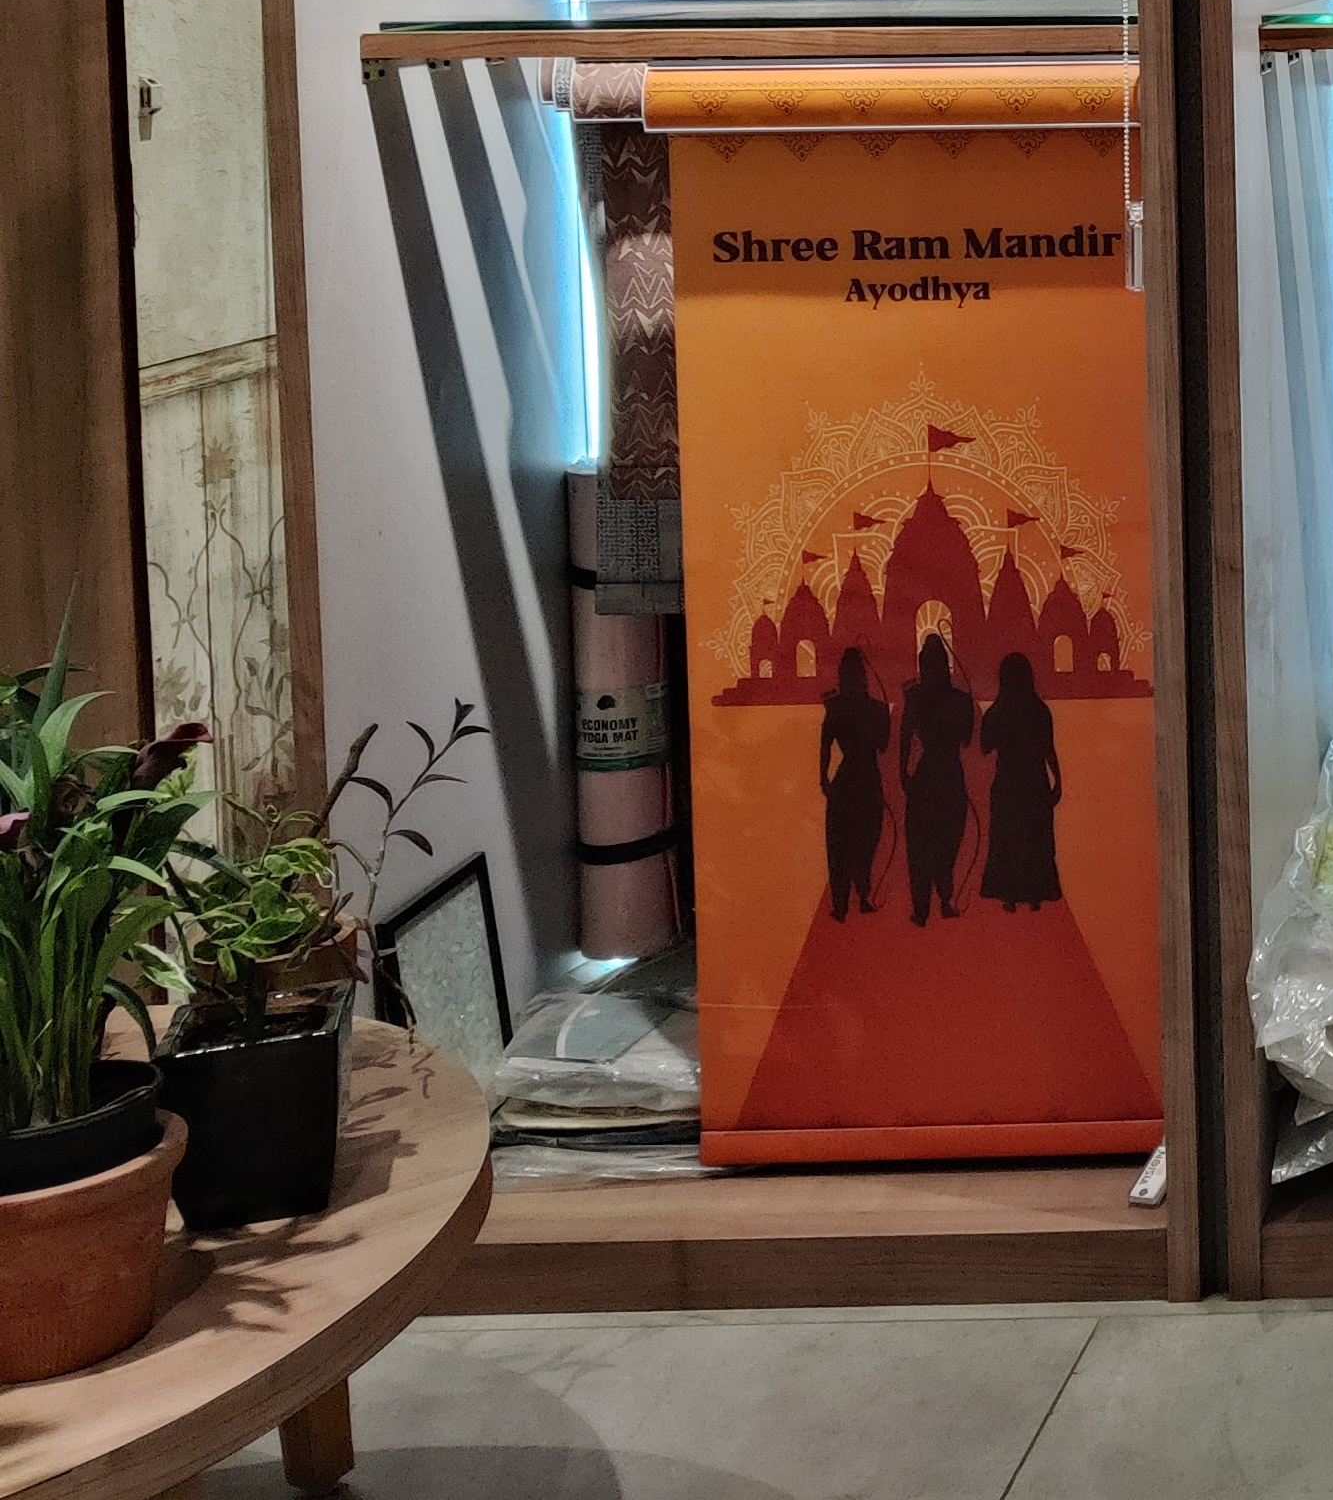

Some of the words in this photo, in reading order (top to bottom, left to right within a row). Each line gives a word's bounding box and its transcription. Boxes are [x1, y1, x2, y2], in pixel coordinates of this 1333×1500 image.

[712, 230, 839, 263] Shree
[851, 230, 950, 261] Ram
[963, 224, 1122, 260] Mandir
[844, 276, 991, 311] Ayodhya
[582, 716, 638, 731] ECONOMY
[612, 730, 638, 743] MAT
